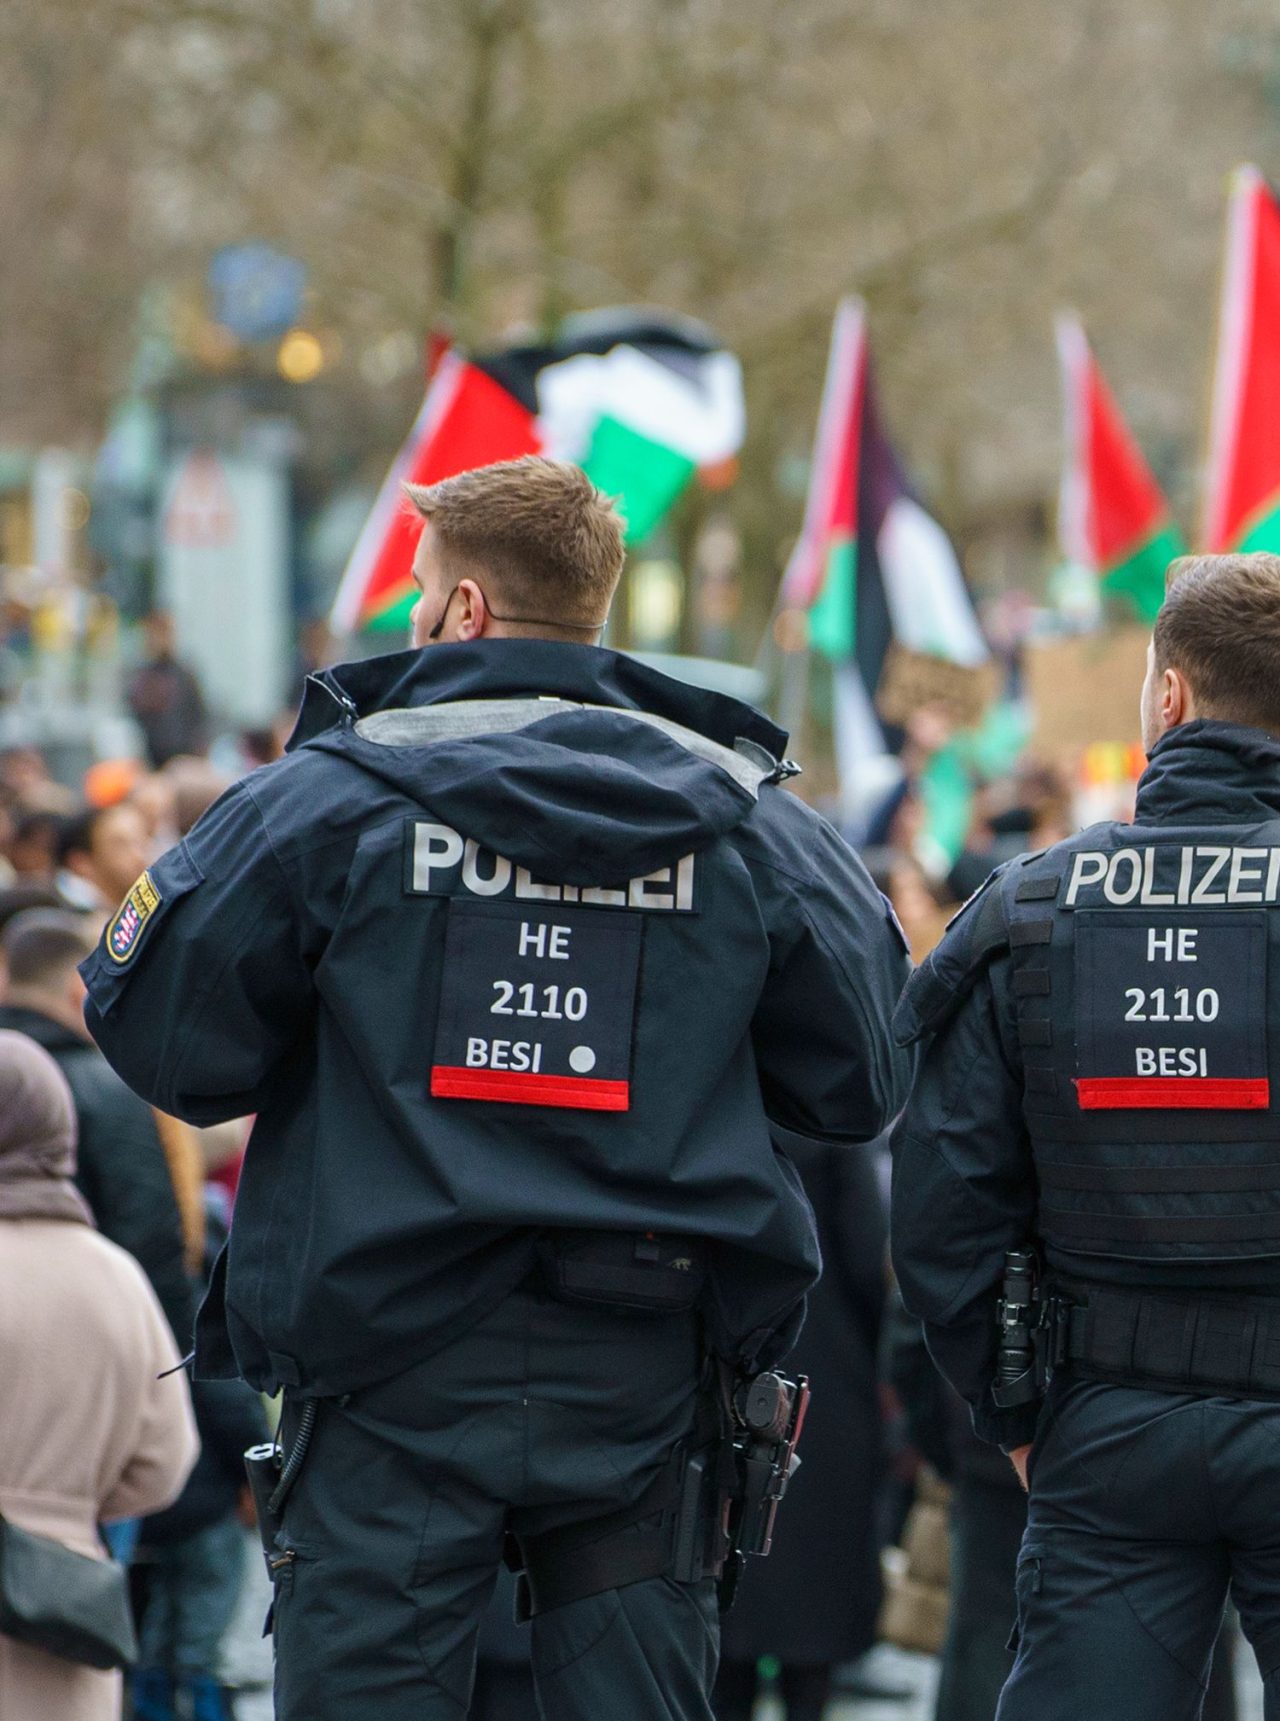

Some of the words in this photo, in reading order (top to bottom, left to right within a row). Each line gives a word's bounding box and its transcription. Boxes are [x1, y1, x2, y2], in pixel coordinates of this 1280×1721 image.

[518, 922, 572, 959] HE
[1147, 928, 1199, 962] HE
[490, 980, 588, 1021] 2110
[1124, 988, 1219, 1022] 2110
[466, 1037, 542, 1073] BESI
[1135, 1047, 1208, 1077] BESI
